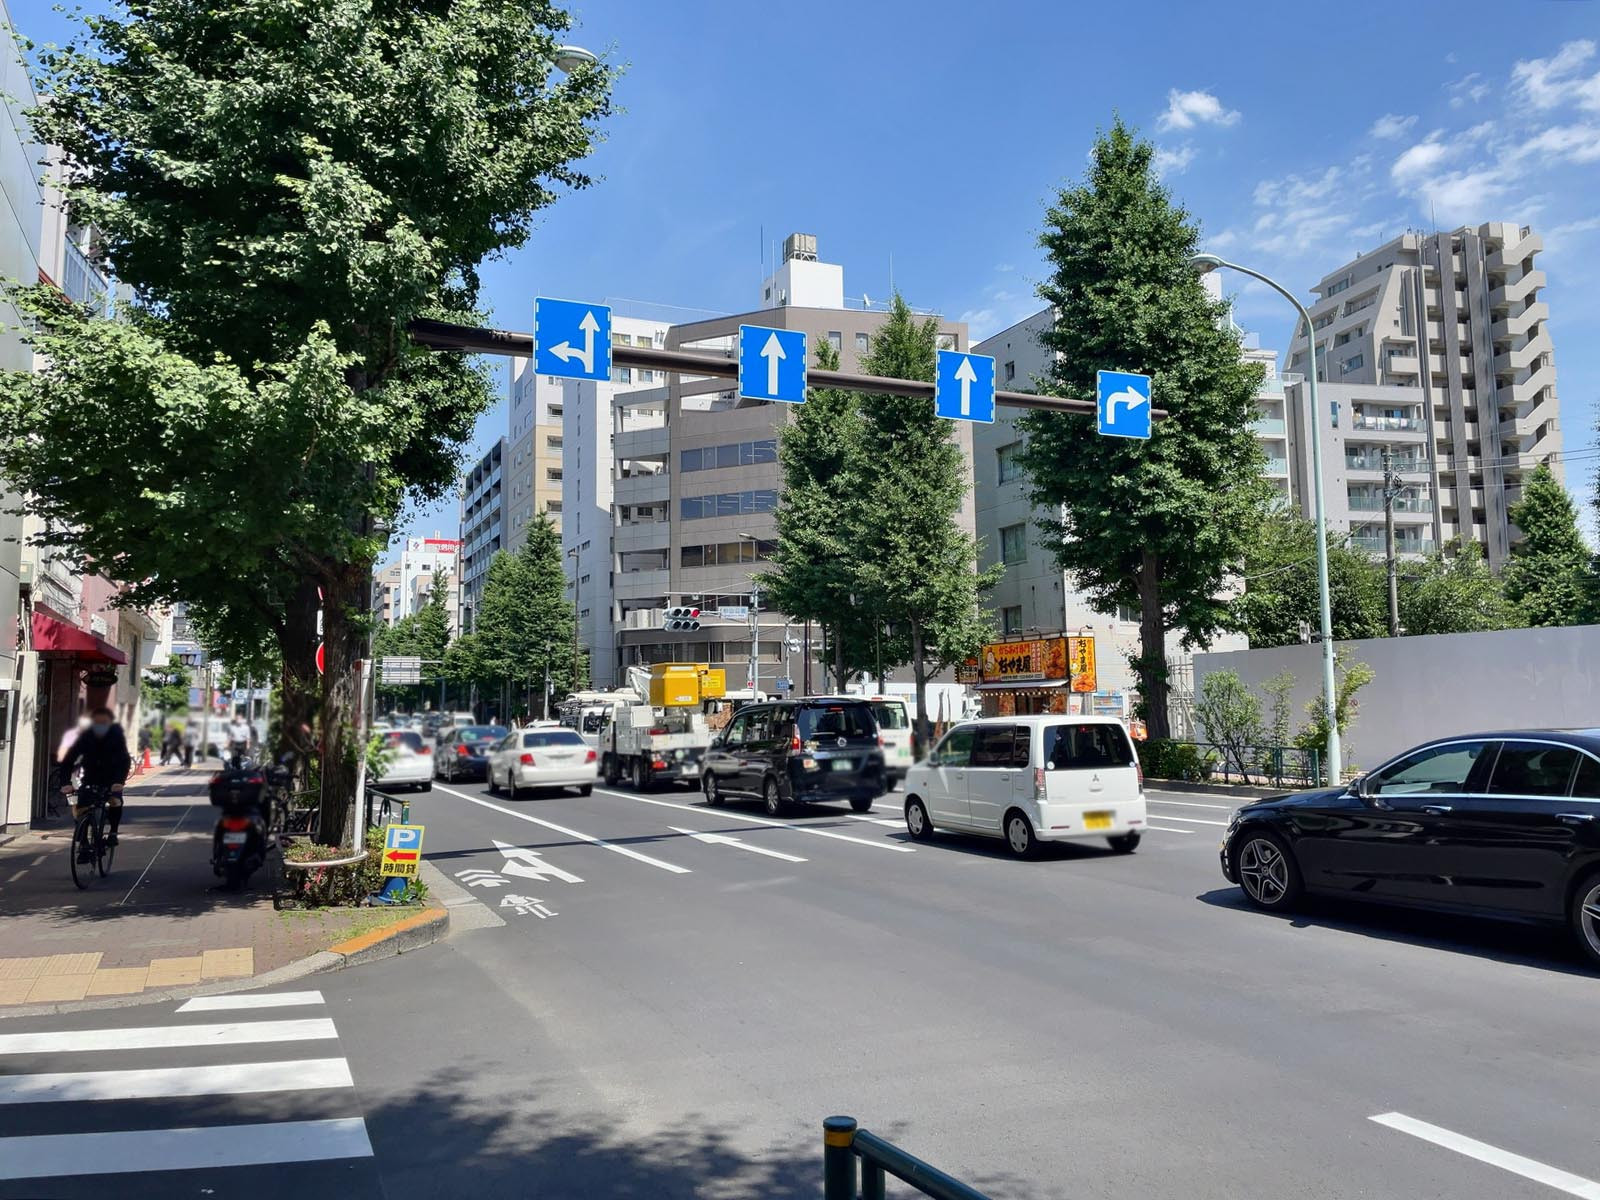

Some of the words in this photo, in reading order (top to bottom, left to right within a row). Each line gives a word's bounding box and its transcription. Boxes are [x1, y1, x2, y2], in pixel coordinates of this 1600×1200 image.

[392, 829, 416, 848] P
[383, 862, 417, 875] 時間貸
